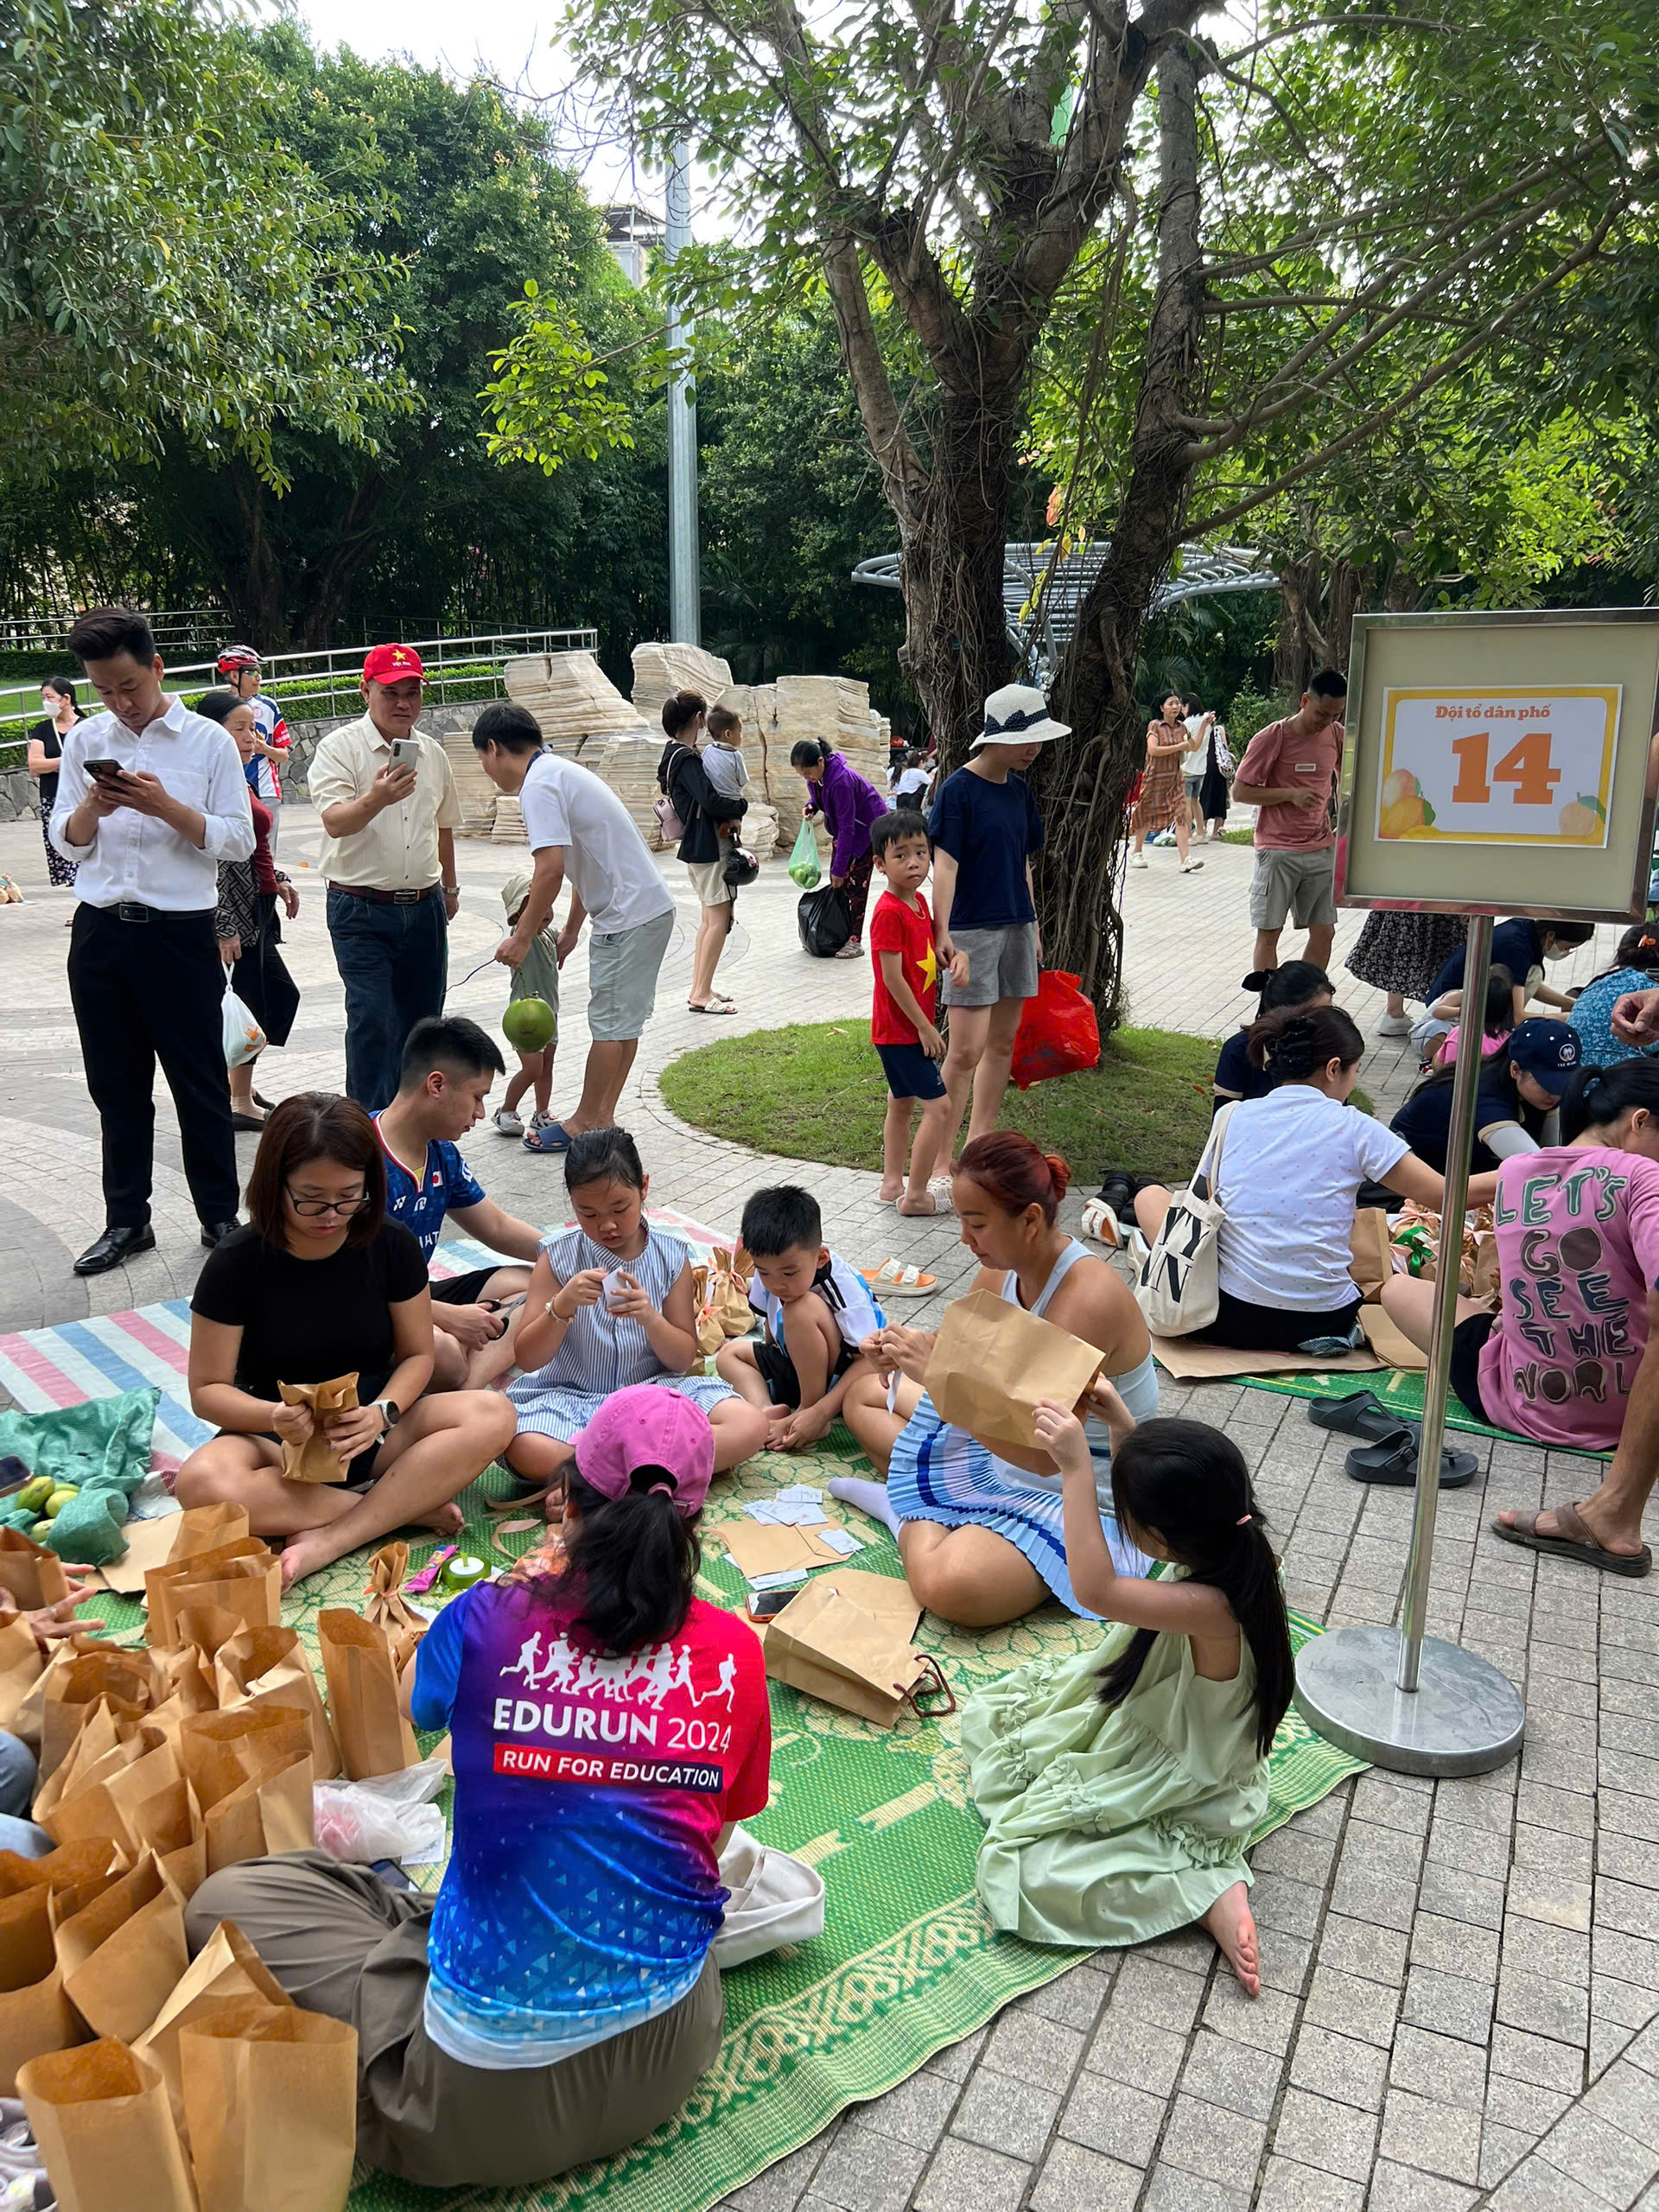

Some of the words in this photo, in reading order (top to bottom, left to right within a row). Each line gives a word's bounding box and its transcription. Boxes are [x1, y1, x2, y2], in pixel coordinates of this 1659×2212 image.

[1435, 706, 1463, 721] Đội
[1465, 703, 1481, 719] tổ
[1484, 705, 1516, 719] dân
[1517, 703, 1552, 721] phố
[1452, 732, 1561, 804] 14
[1496, 1166, 1628, 1227] LET'S
[1520, 1226, 1604, 1278] GO
[1510, 1272, 1630, 1320] SEE
[1519, 1313, 1637, 1358] THE
[493, 1698, 658, 1746] EDURUN
[667, 1717, 732, 1755] 2024
[503, 1750, 551, 1772] RUN
[557, 1757, 603, 1778] FOR
[609, 1762, 720, 1788] EDUCATION
